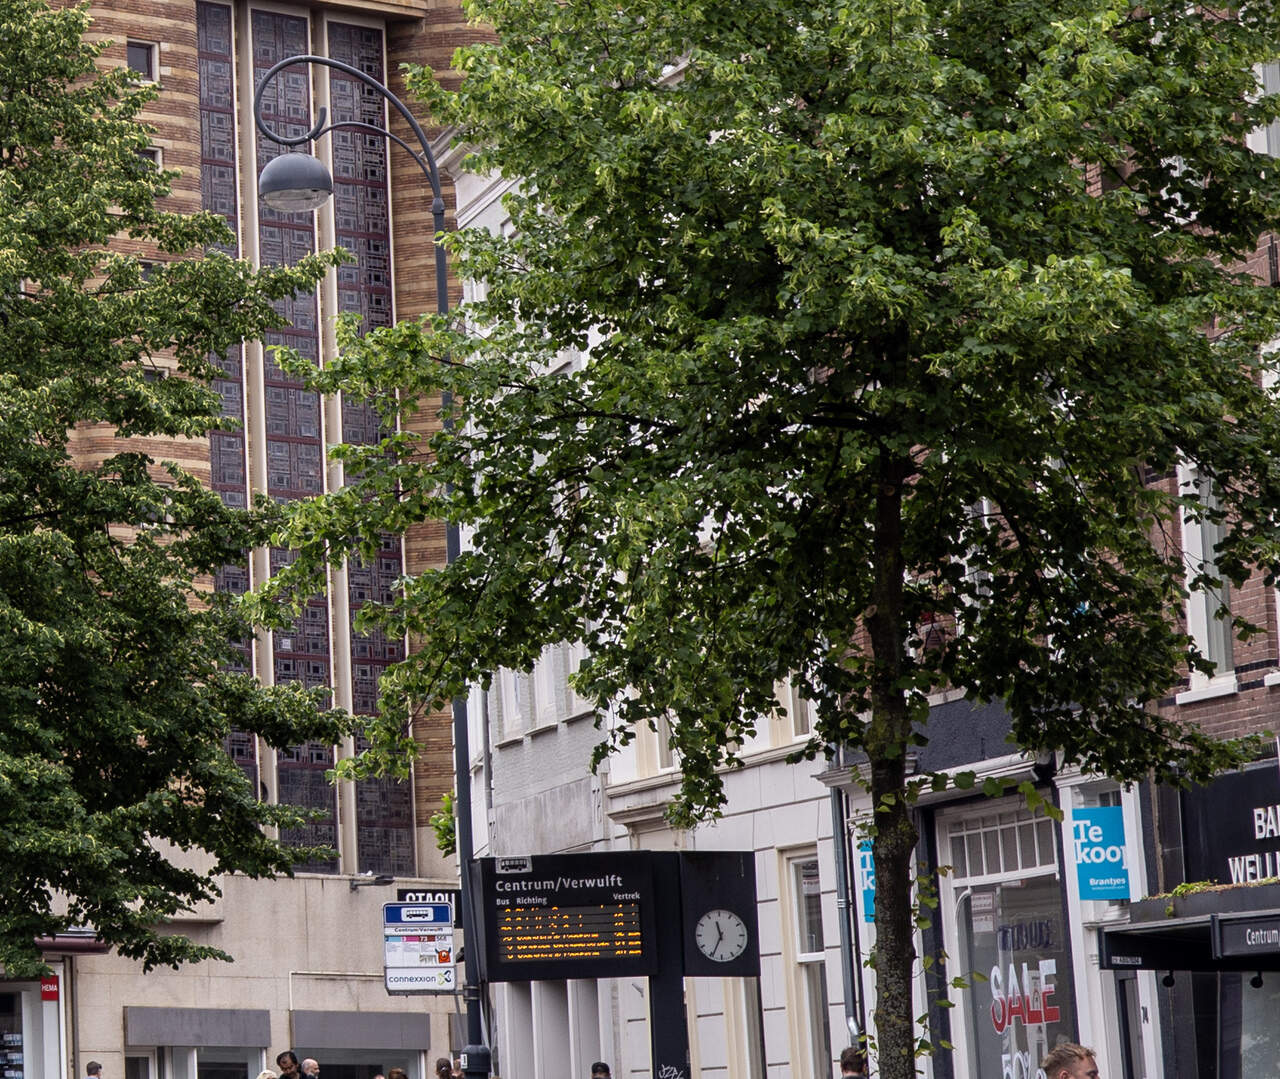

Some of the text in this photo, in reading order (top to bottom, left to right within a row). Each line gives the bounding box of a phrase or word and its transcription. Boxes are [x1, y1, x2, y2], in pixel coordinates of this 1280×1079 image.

[1072, 820, 1103, 843] Te
[495, 875, 624, 892] Centrum/Verwulft
[496, 892, 641, 906] Bus Richting Vertrek
[388, 975, 437, 983] connexxion
[990, 958, 1061, 1035] SALE
